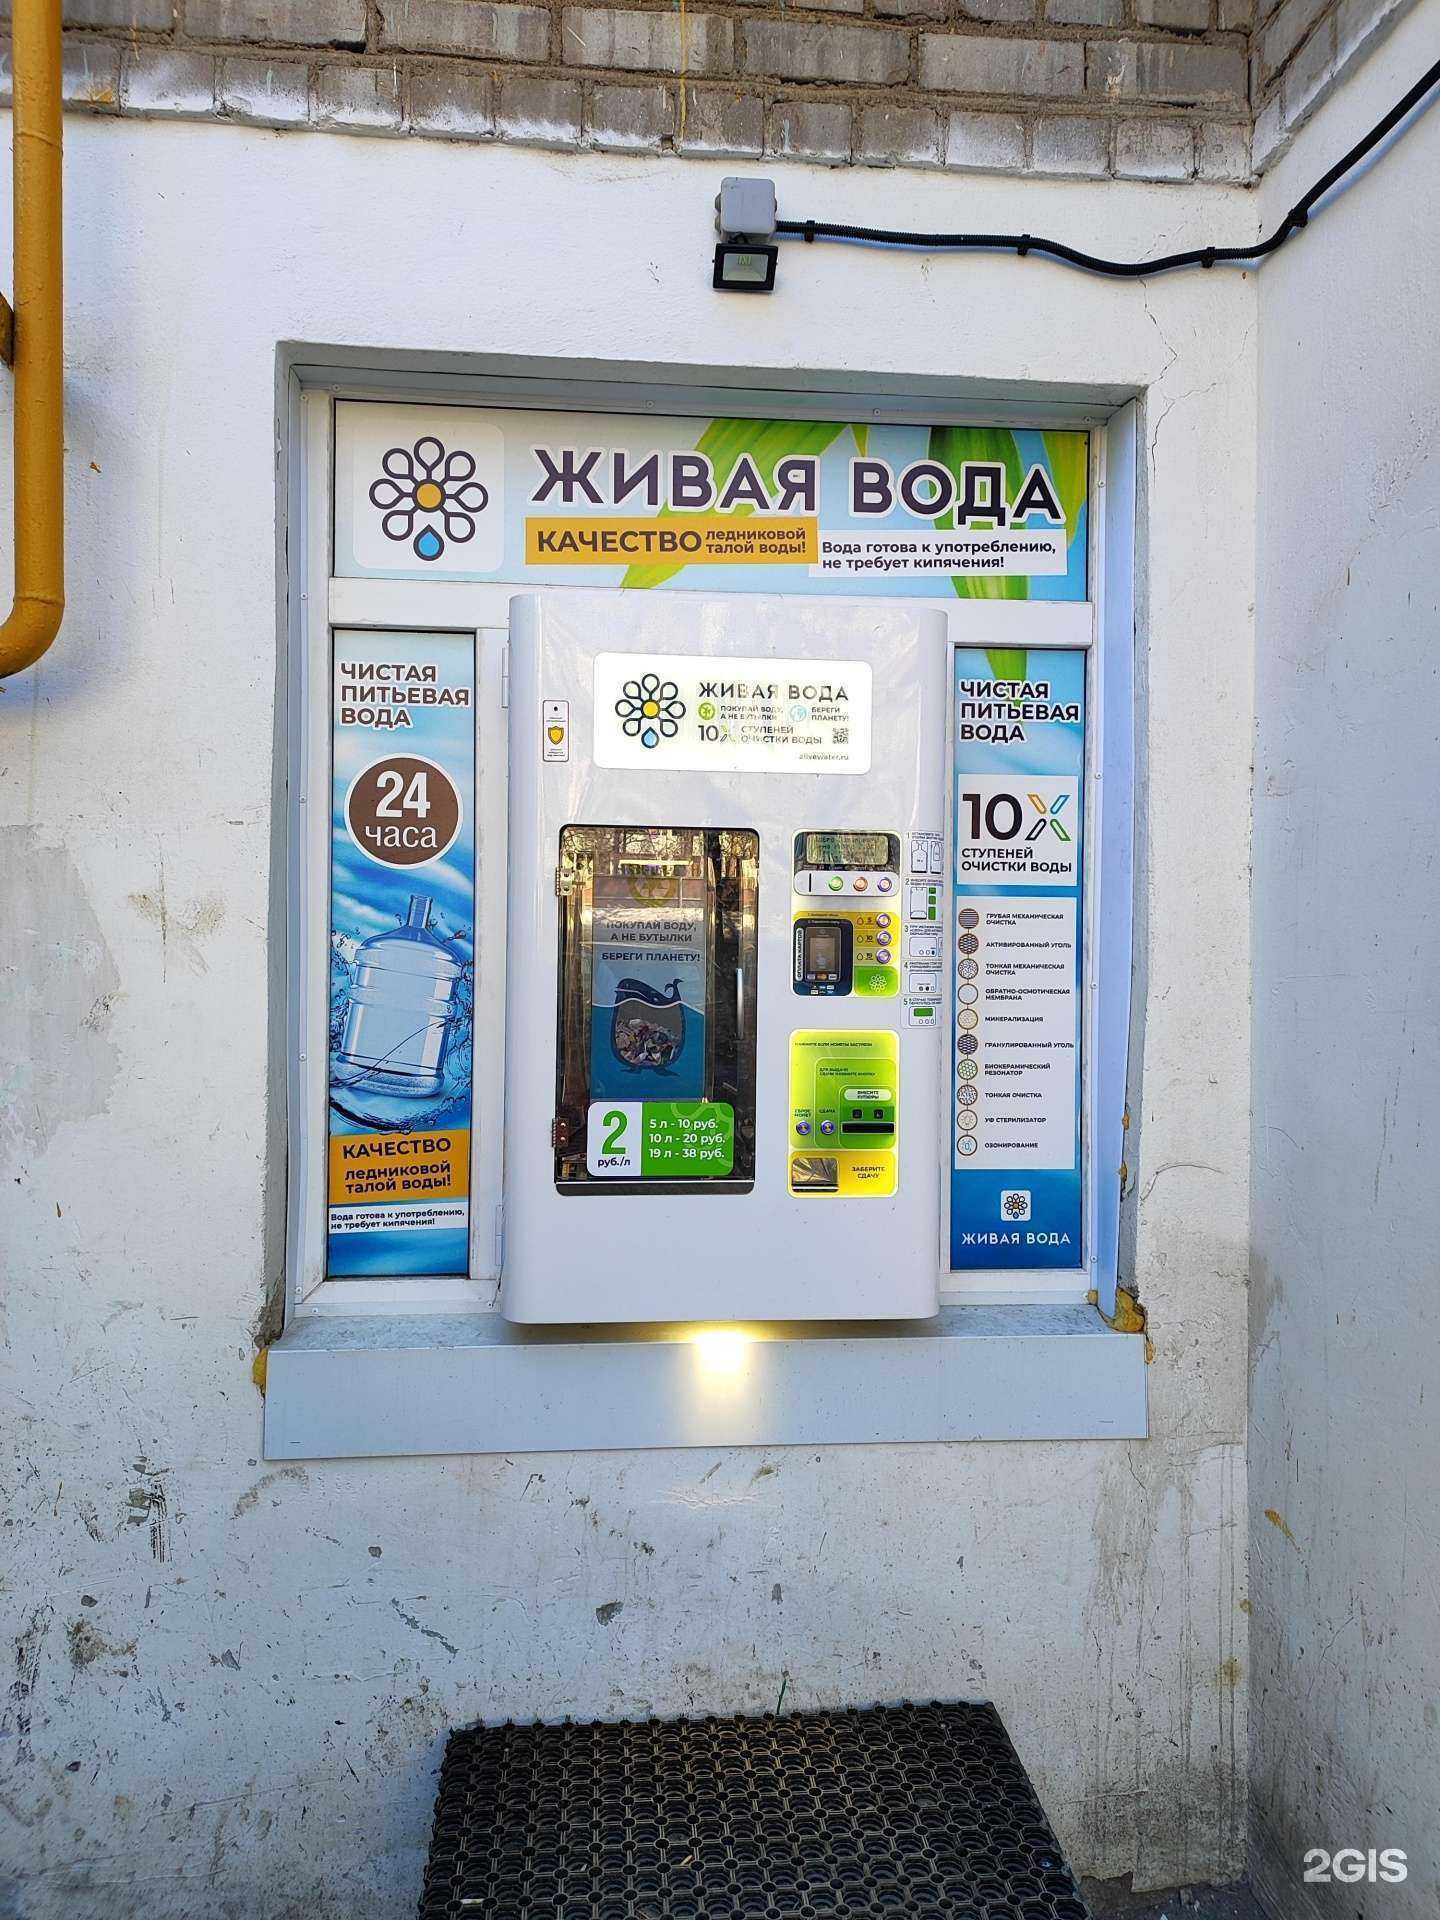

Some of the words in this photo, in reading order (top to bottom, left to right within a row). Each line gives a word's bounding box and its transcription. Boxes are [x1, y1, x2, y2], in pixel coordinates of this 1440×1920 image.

[531, 448, 816, 511] ЖИВАЯ
[853, 461, 1062, 527] ВОДА
[537, 530, 702, 553] КАЧЕСТВО
[706, 527, 806, 542] ледниковой
[706, 541, 754, 554] талой
[759, 543, 806, 555] воды!
[822, 541, 862, 555] Вода
[866, 543, 917, 553] готова
[922, 543, 931, 553] к
[935, 541, 1057, 556] употреблению,
[822, 558, 842, 569] не
[846, 557, 908, 572] требует
[913, 557, 1005, 569] кипячения!
[341, 662, 436, 682] ЧИСТАЯ
[341, 686, 470, 706] ПИТЬЕВАЯ
[698, 682, 779, 699] ЖИВАЯ
[788, 684, 849, 703] ВОДА
[961, 681, 1049, 699] ЧИСТАЯ
[341, 708, 411, 728] ВОДА
[961, 703, 1079, 721] ПИТЬЕВАЯ
[741, 725, 794, 734] СТУПЕНЕЙ
[961, 724, 1025, 744] ВОДА
[376, 770, 431, 818] 24
[365, 825, 438, 849] часа
[961, 846, 1033, 859] СТУПЕНЕЙ
[961, 861, 1026, 872] ОЧИСТКИ
[1030, 862, 1072, 874] ВОДЫ
[606, 920, 661, 931] ПОКУПАЙ
[664, 921, 697, 933] ВОДУ,
[610, 933, 620, 941] А
[621, 933, 637, 941] НЕ
[639, 933, 693, 943] БУТЫЛКИ
[601, 952, 644, 962] БЕРЕГИ
[646, 952, 701, 963] ПЛАНЕТУ!
[602, 1110, 628, 1154] 2
[649, 1119, 657, 1128] 5
[659, 1120, 668, 1128] л
[678, 1119, 691, 1128] 10
[693, 1119, 718, 1131] руб.
[649, 1133, 662, 1143] 10
[664, 1135, 673, 1143] л
[683, 1133, 698, 1143] 20
[700, 1133, 725, 1146] руб.
[343, 1137, 452, 1159] КАЧЕСТВО
[649, 1148, 662, 1158] 19
[664, 1150, 672, 1158] л
[682, 1148, 697, 1158] 38
[699, 1148, 725, 1160] руб.
[598, 1156, 631, 1168] руб./л
[345, 1160, 451, 1181] ледниковой
[345, 1178, 397, 1194] талой
[402, 1174, 451, 1190] воды!
[331, 1213, 354, 1221] Вода
[395, 1208, 465, 1220] употреблению,
[345, 1220, 381, 1231] требует
[382, 1218, 435, 1227] кипячения!
[962, 1232, 1020, 1245] ЖИВАЯ
[1026, 1233, 1072, 1246] ВОДА
